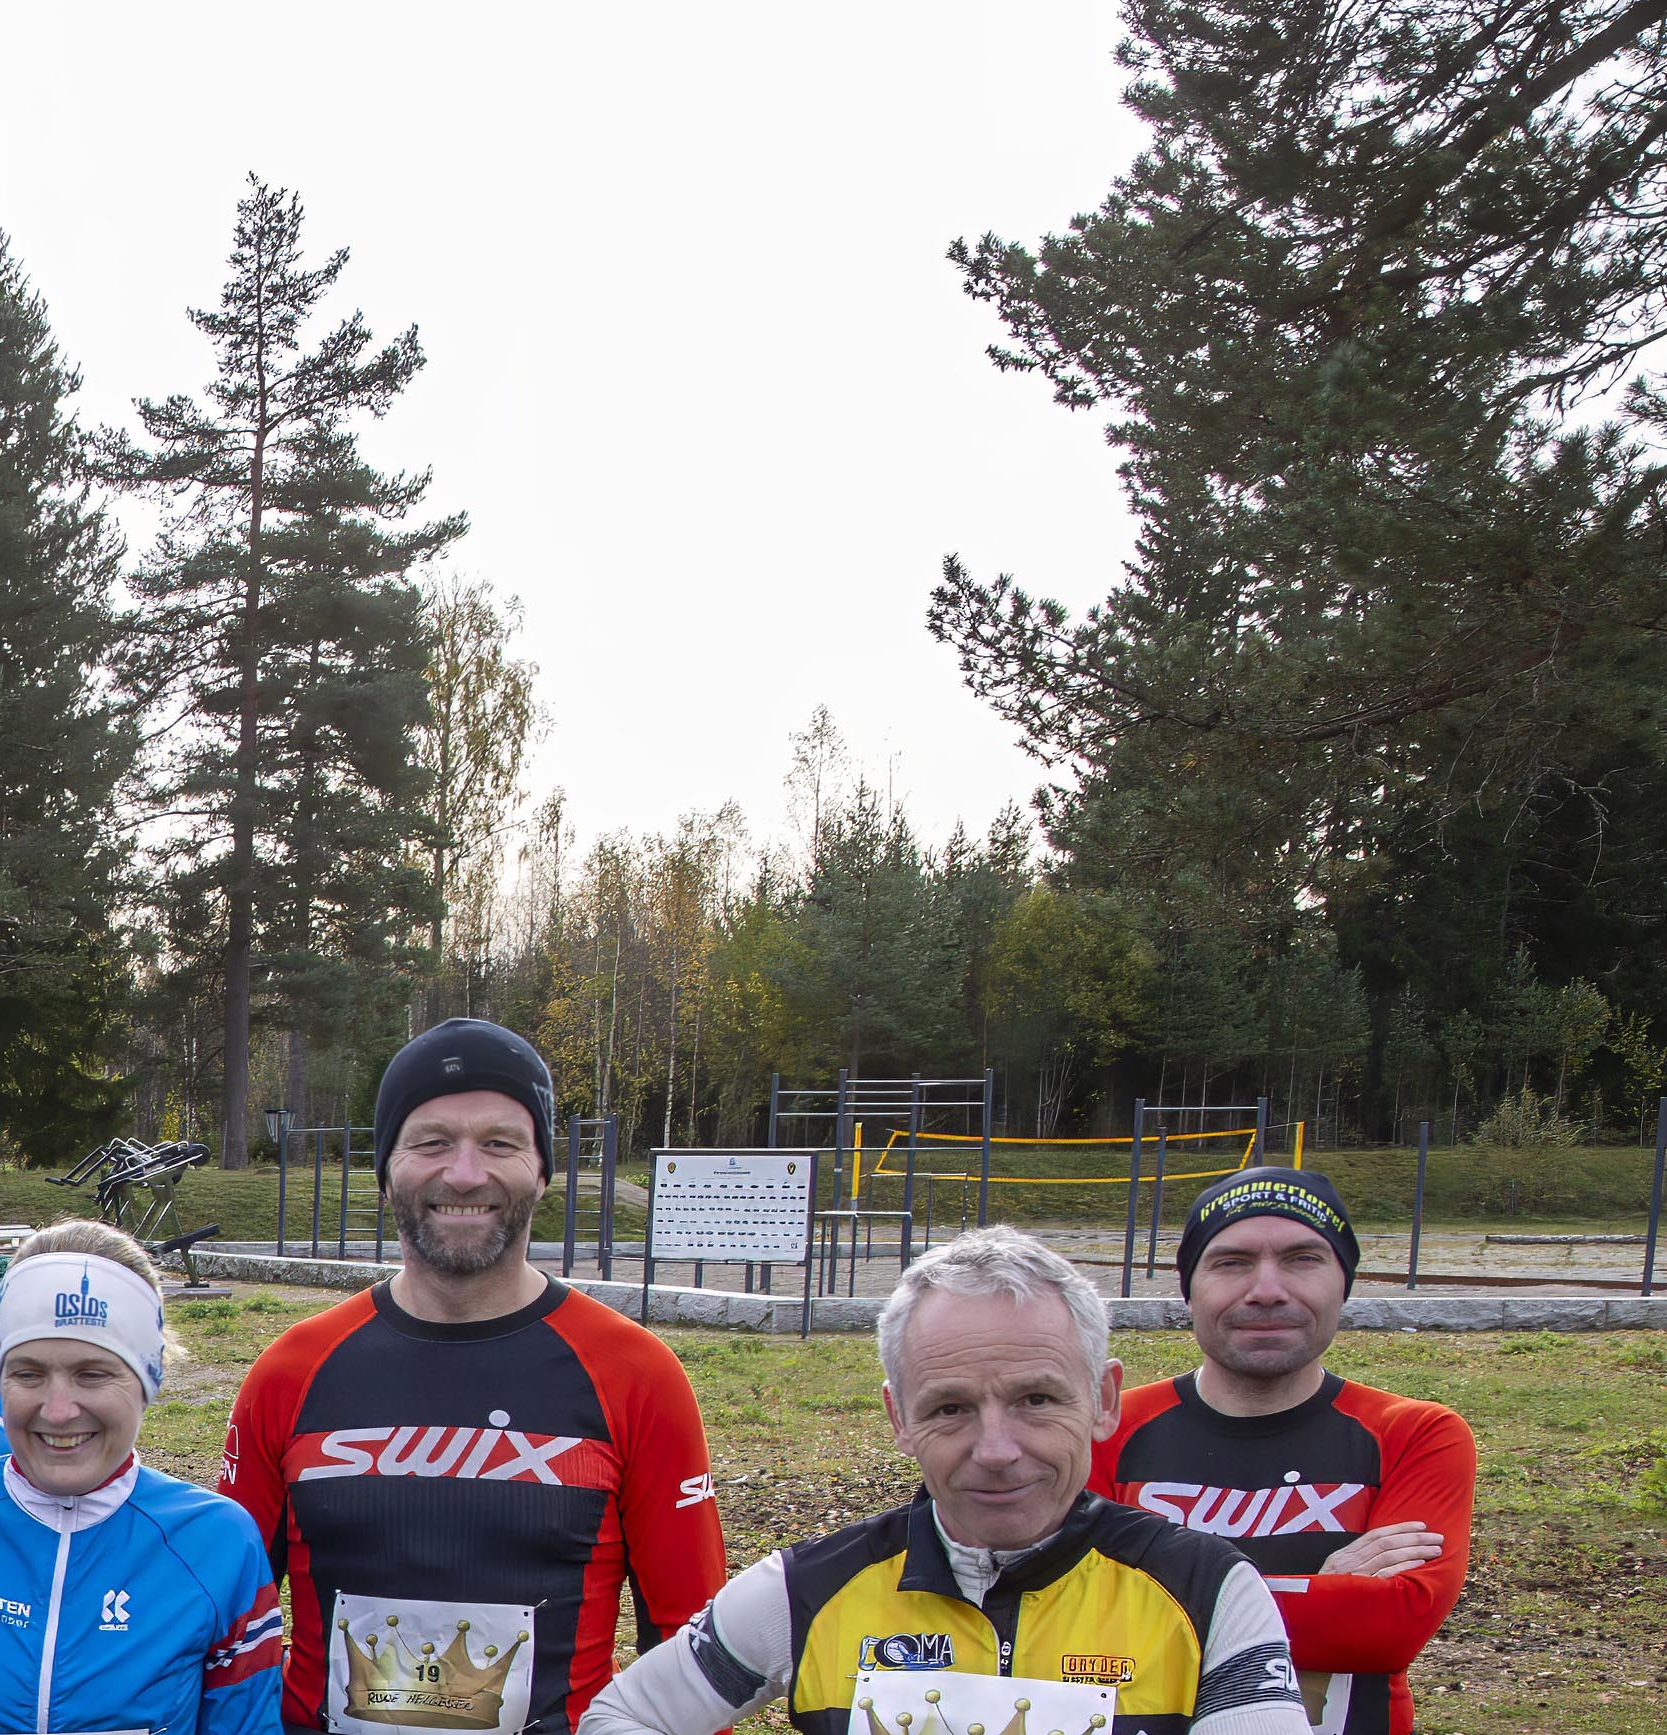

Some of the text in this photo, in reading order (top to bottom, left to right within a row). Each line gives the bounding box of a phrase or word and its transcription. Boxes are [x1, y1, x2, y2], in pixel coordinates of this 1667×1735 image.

[1222, 1191, 1327, 1223] SPORT & FRITID
[415, 1664, 441, 1683] 19
